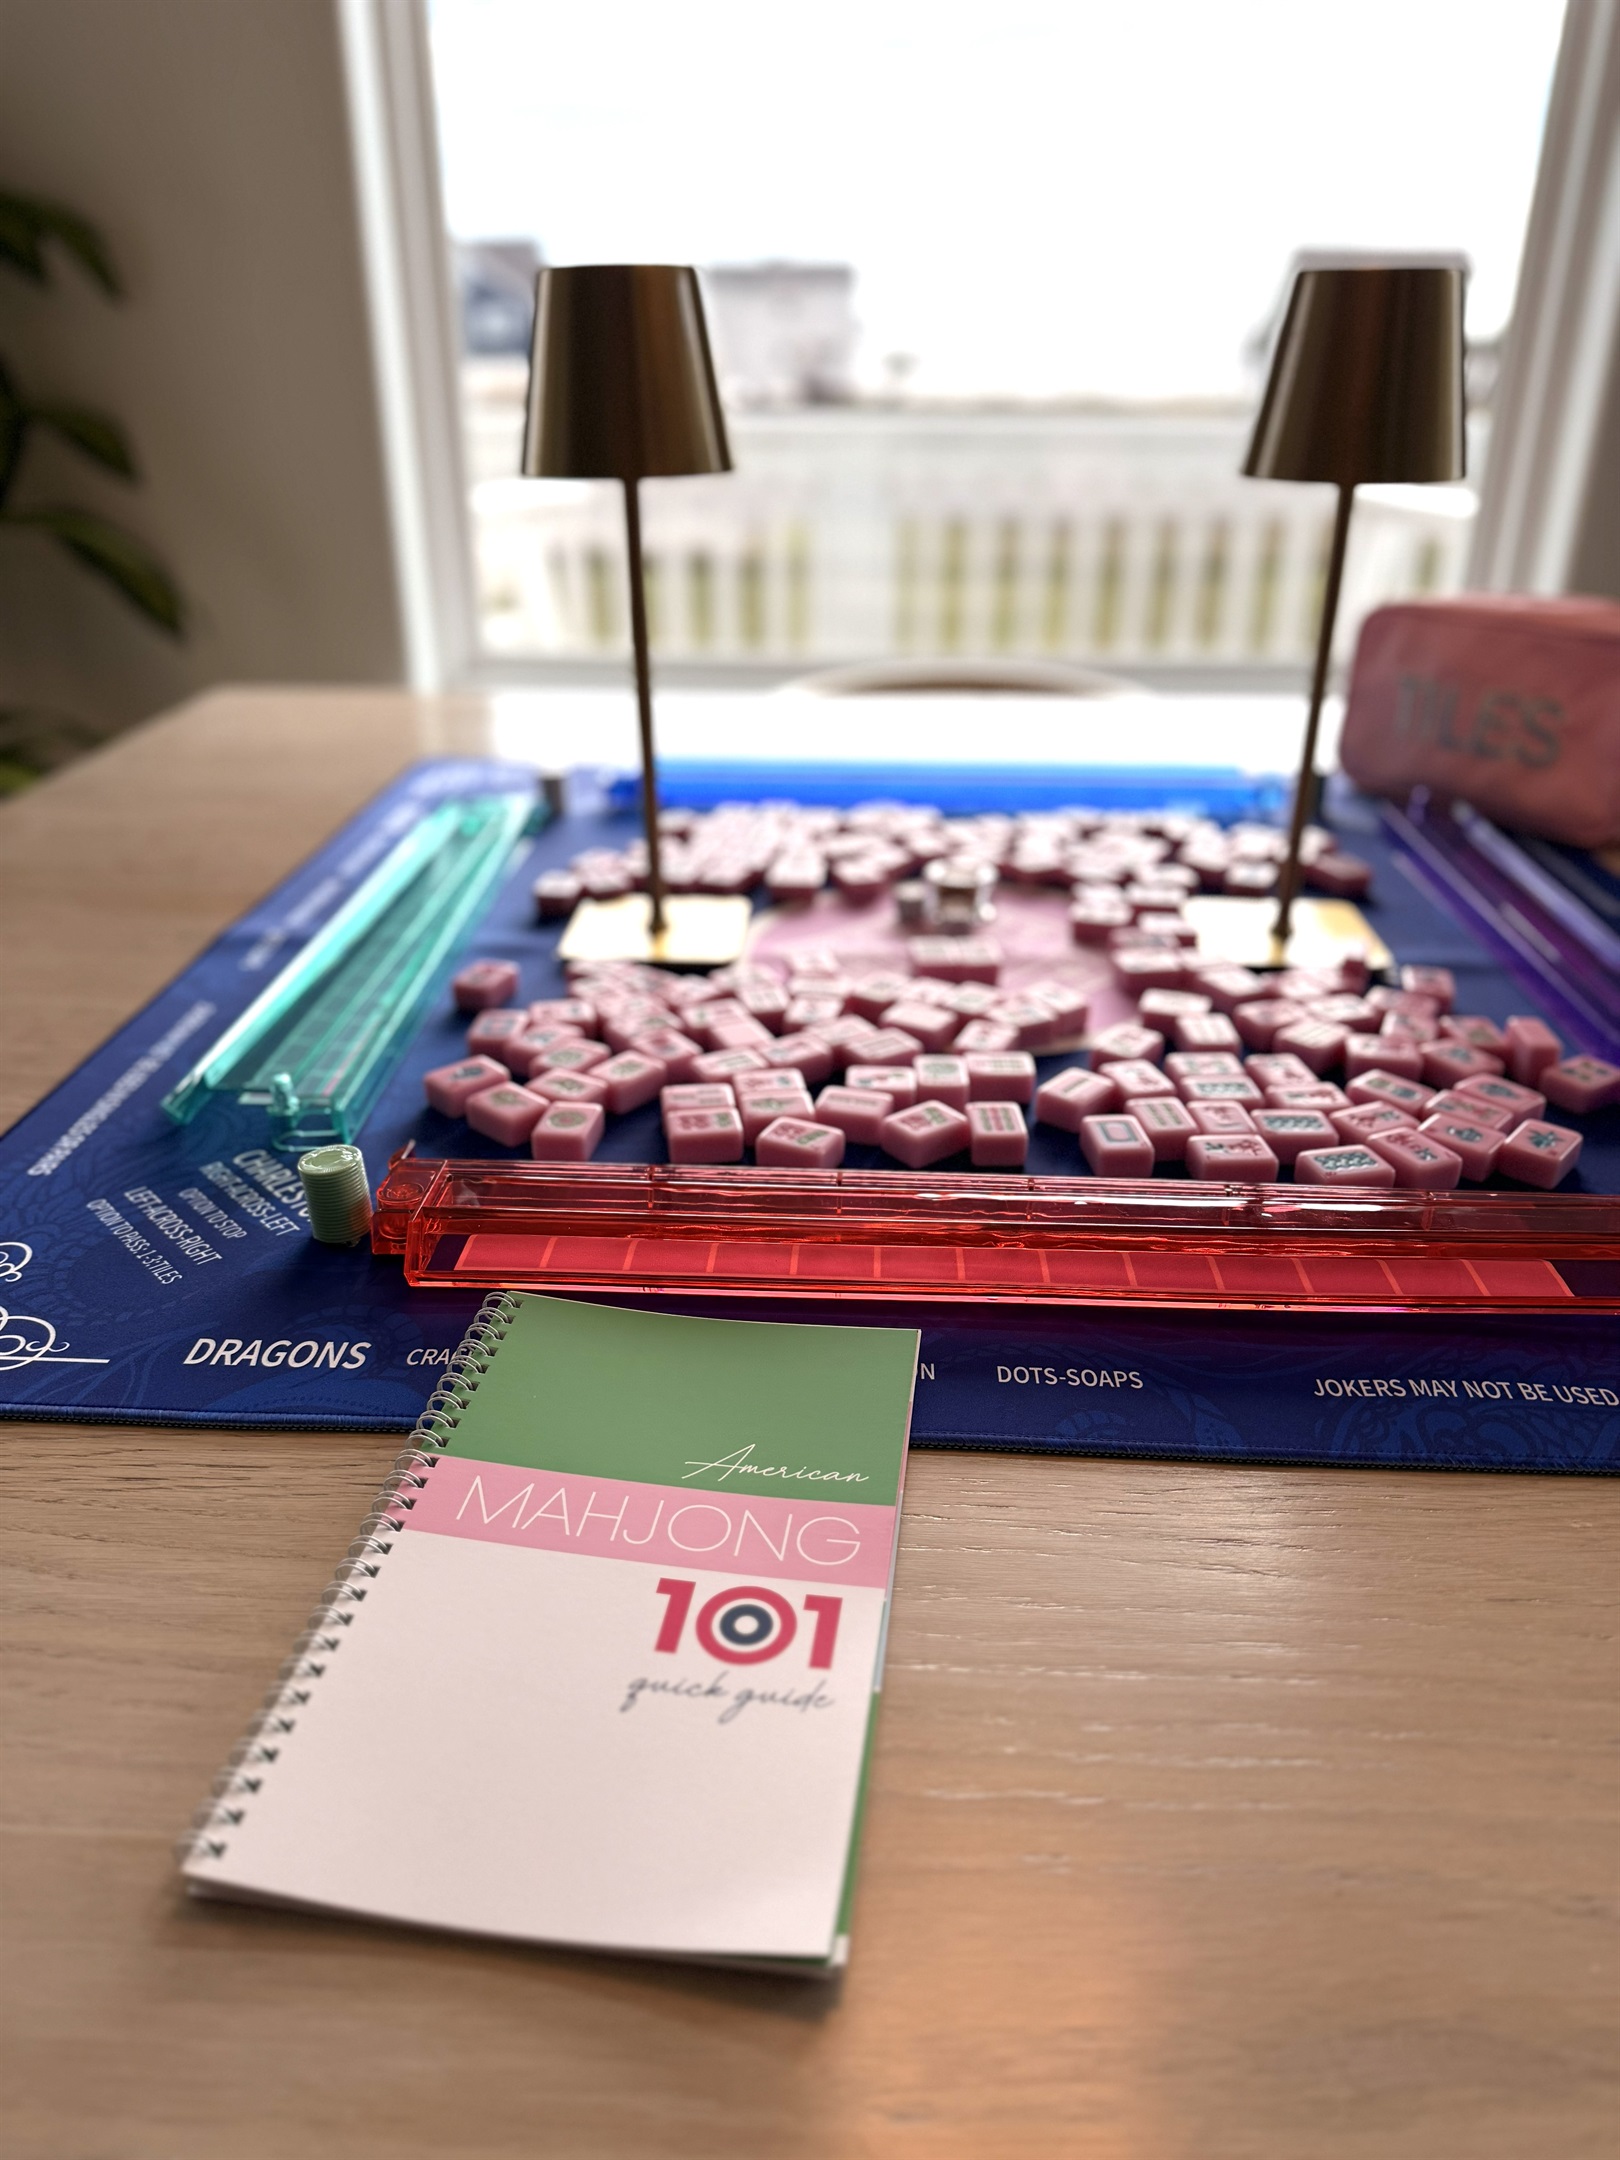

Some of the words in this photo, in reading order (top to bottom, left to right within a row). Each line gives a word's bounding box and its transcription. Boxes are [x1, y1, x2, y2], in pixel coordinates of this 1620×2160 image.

[86, 1198, 125, 1226] OPTION
[110, 1221, 134, 1235] TO
[179, 1187, 218, 1215] OPTION
[205, 1209, 228, 1223] TO
[124, 1186, 222, 1265] LEFT-ACROSS-RIGHT
[214, 1219, 247, 1239] STOP
[183, 1338, 372, 1370] DRAGONS
[996, 1365, 1144, 1389] DOTS-SOAPS
[1314, 1378, 1406, 1398] JOKERS
[1408, 1379, 1459, 1398] MAY
[1461, 1380, 1513, 1400] NOT
[1516, 1382, 1553, 1402] BE
[1552, 1385, 1619, 1406] USED
[682, 1443, 870, 1483] American
[456, 1475, 861, 1566] MAHJONG
[654, 1577, 843, 1671] 101
[618, 1671, 729, 1714] quick
[714, 1679, 835, 1725] guide
